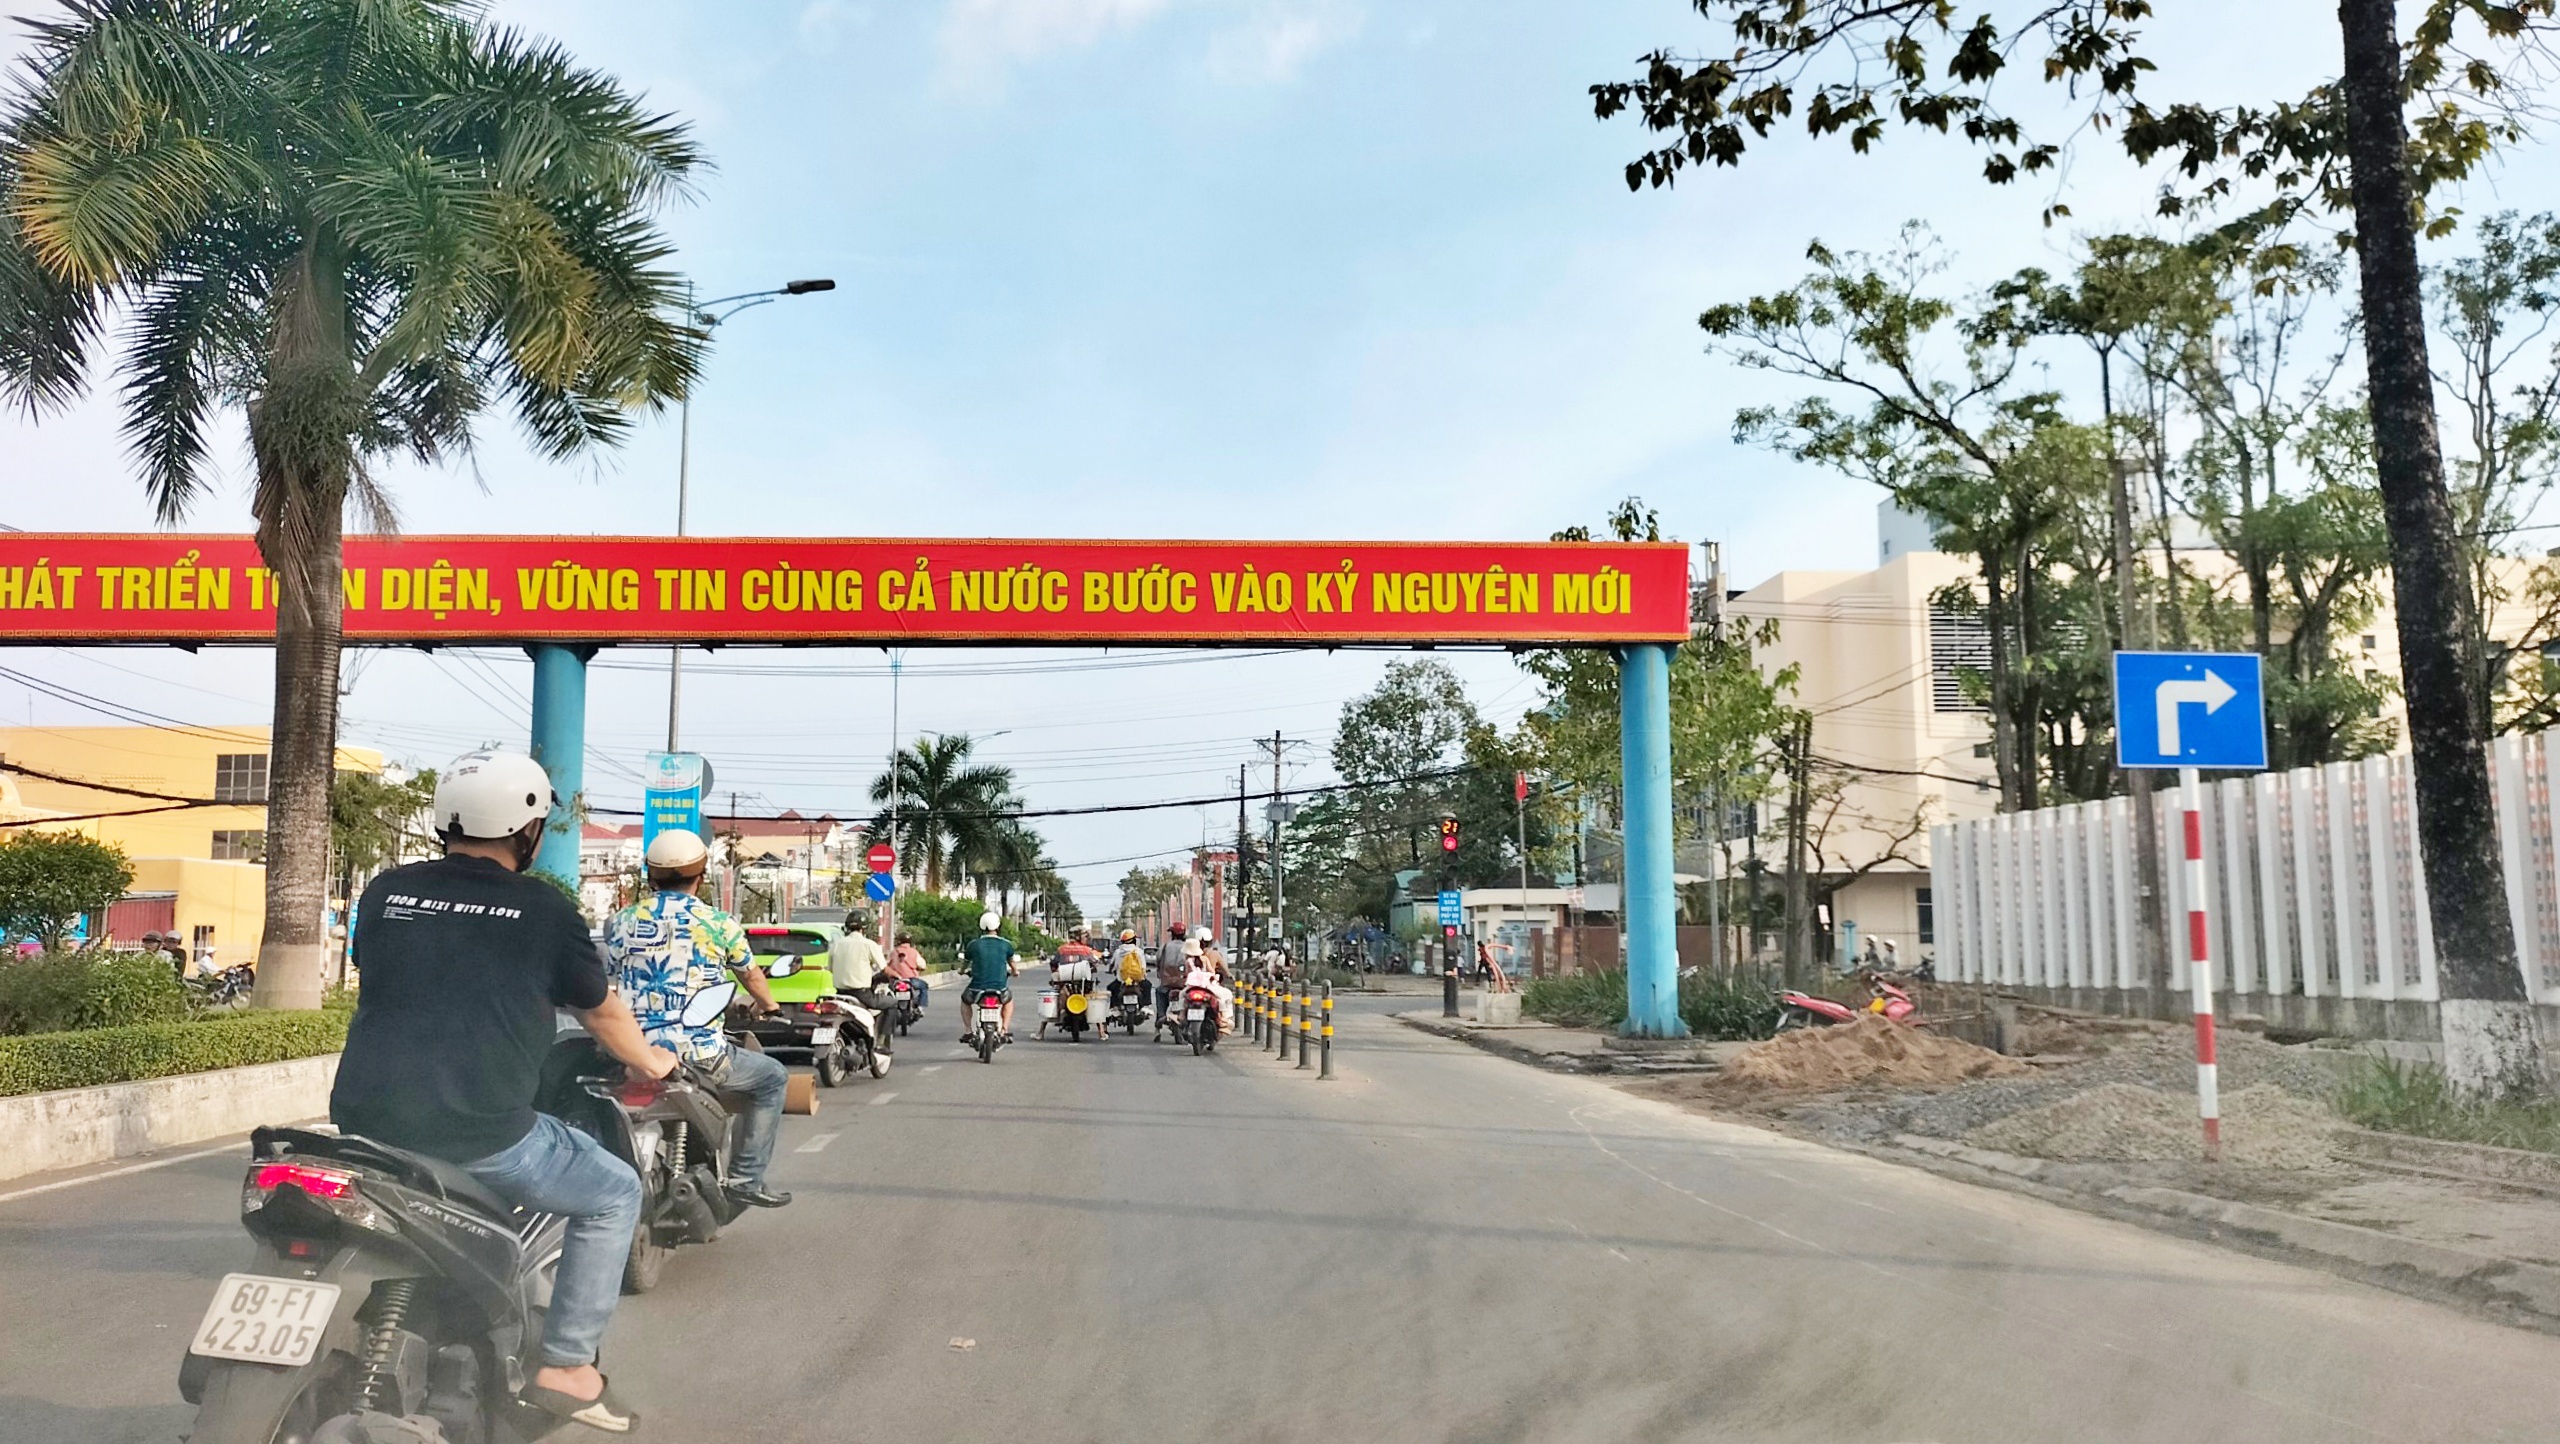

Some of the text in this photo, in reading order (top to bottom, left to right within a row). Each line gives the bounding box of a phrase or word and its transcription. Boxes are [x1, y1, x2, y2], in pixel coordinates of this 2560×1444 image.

[96, 549, 231, 610] TRIỂN
[245, 565, 366, 611] TN
[381, 560, 502, 620] DIỆN,
[517, 560, 639, 611] VỮNG
[655, 569, 726, 611] TIN
[742, 561, 862, 612] CÙNG
[878, 556, 936, 611] CẢ
[951, 562, 1068, 613] NƯỚC
[1083, 563, 1196, 613] BƯỚC
[1211, 564, 1292, 613] VÀO
[1307, 558, 1358, 613] KỶ
[1373, 566, 1539, 614] NGUYÊN
[1553, 565, 1631, 614] MỚI
[385, 894, 522, 919] FROM MIXI WITH LOVE
[230, 1282, 317, 1321] 69-F1
[203, 1317, 316, 1359] 423.05
